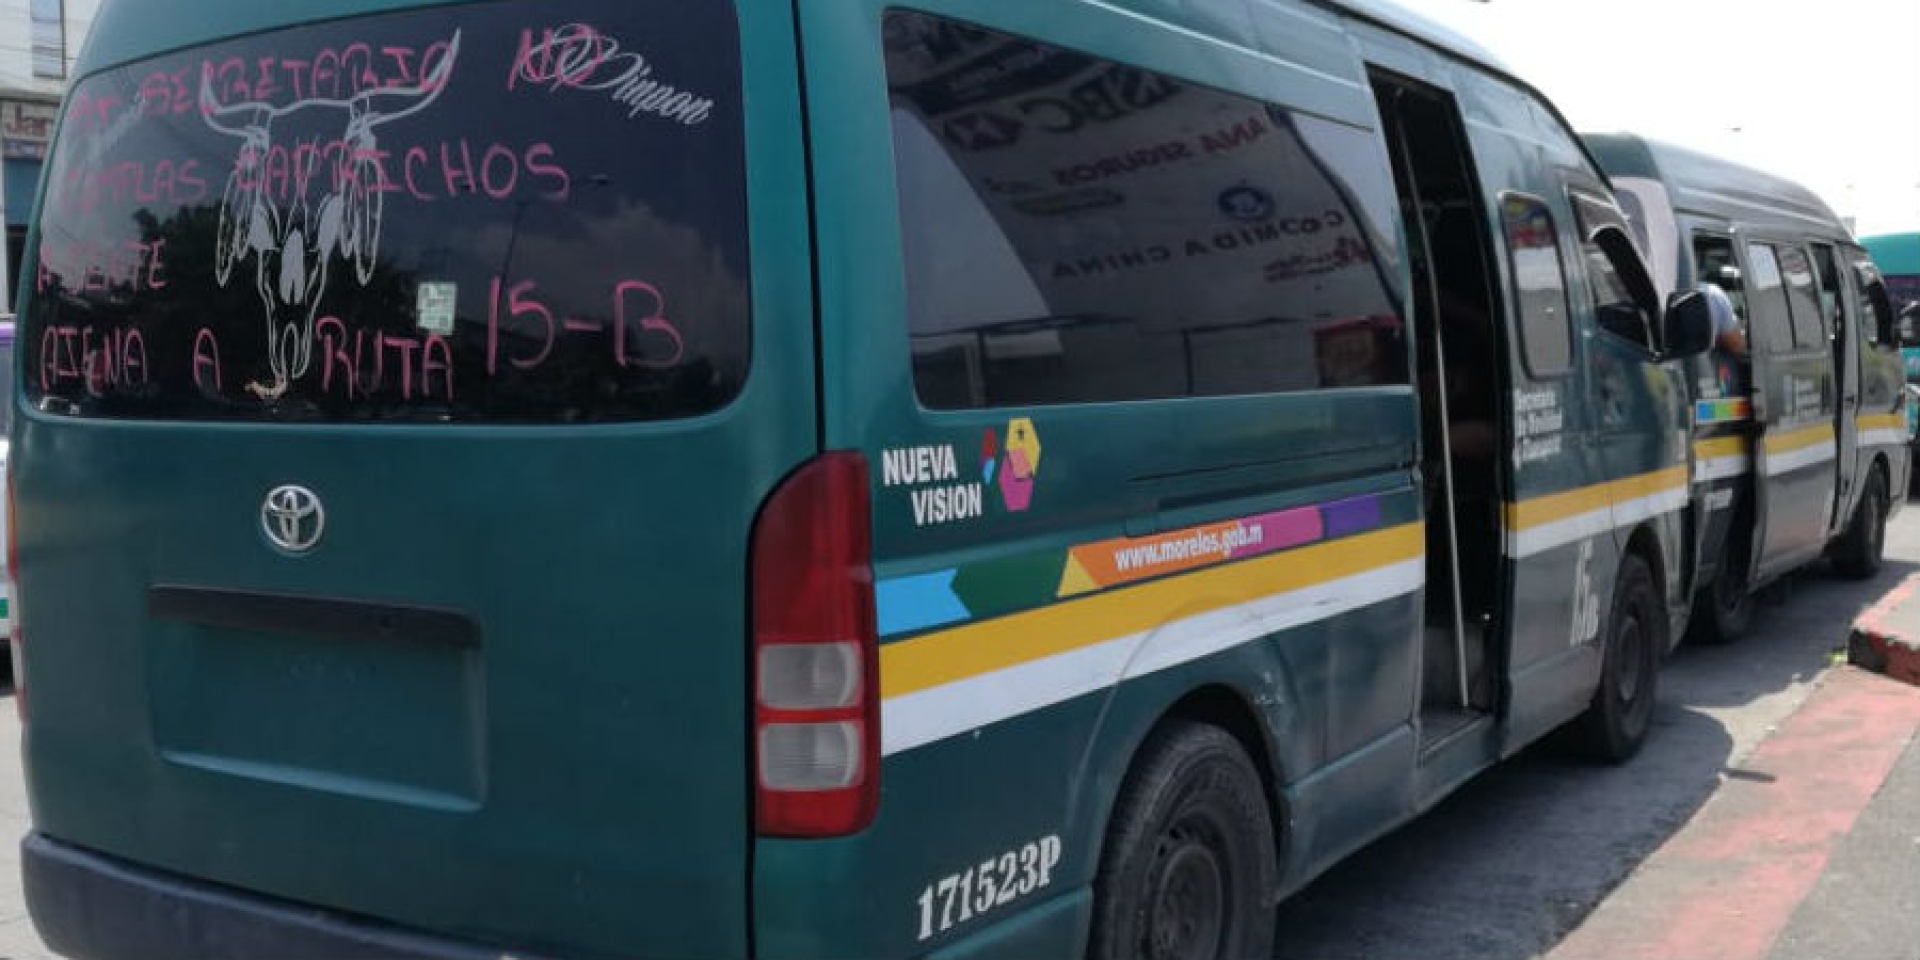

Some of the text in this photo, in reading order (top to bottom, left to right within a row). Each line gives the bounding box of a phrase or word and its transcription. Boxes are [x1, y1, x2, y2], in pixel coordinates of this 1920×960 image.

[508, 27, 607, 93] NO
[236, 139, 571, 199] CAPRICHOS
[192, 328, 221, 392] A
[316, 316, 455, 401] RUTA
[882, 443, 958, 488] NUEVA
[911, 482, 983, 526] VISION
[1115, 521, 1263, 572] www.morelos.gob.m
[917, 834, 1062, 942] 171523P
